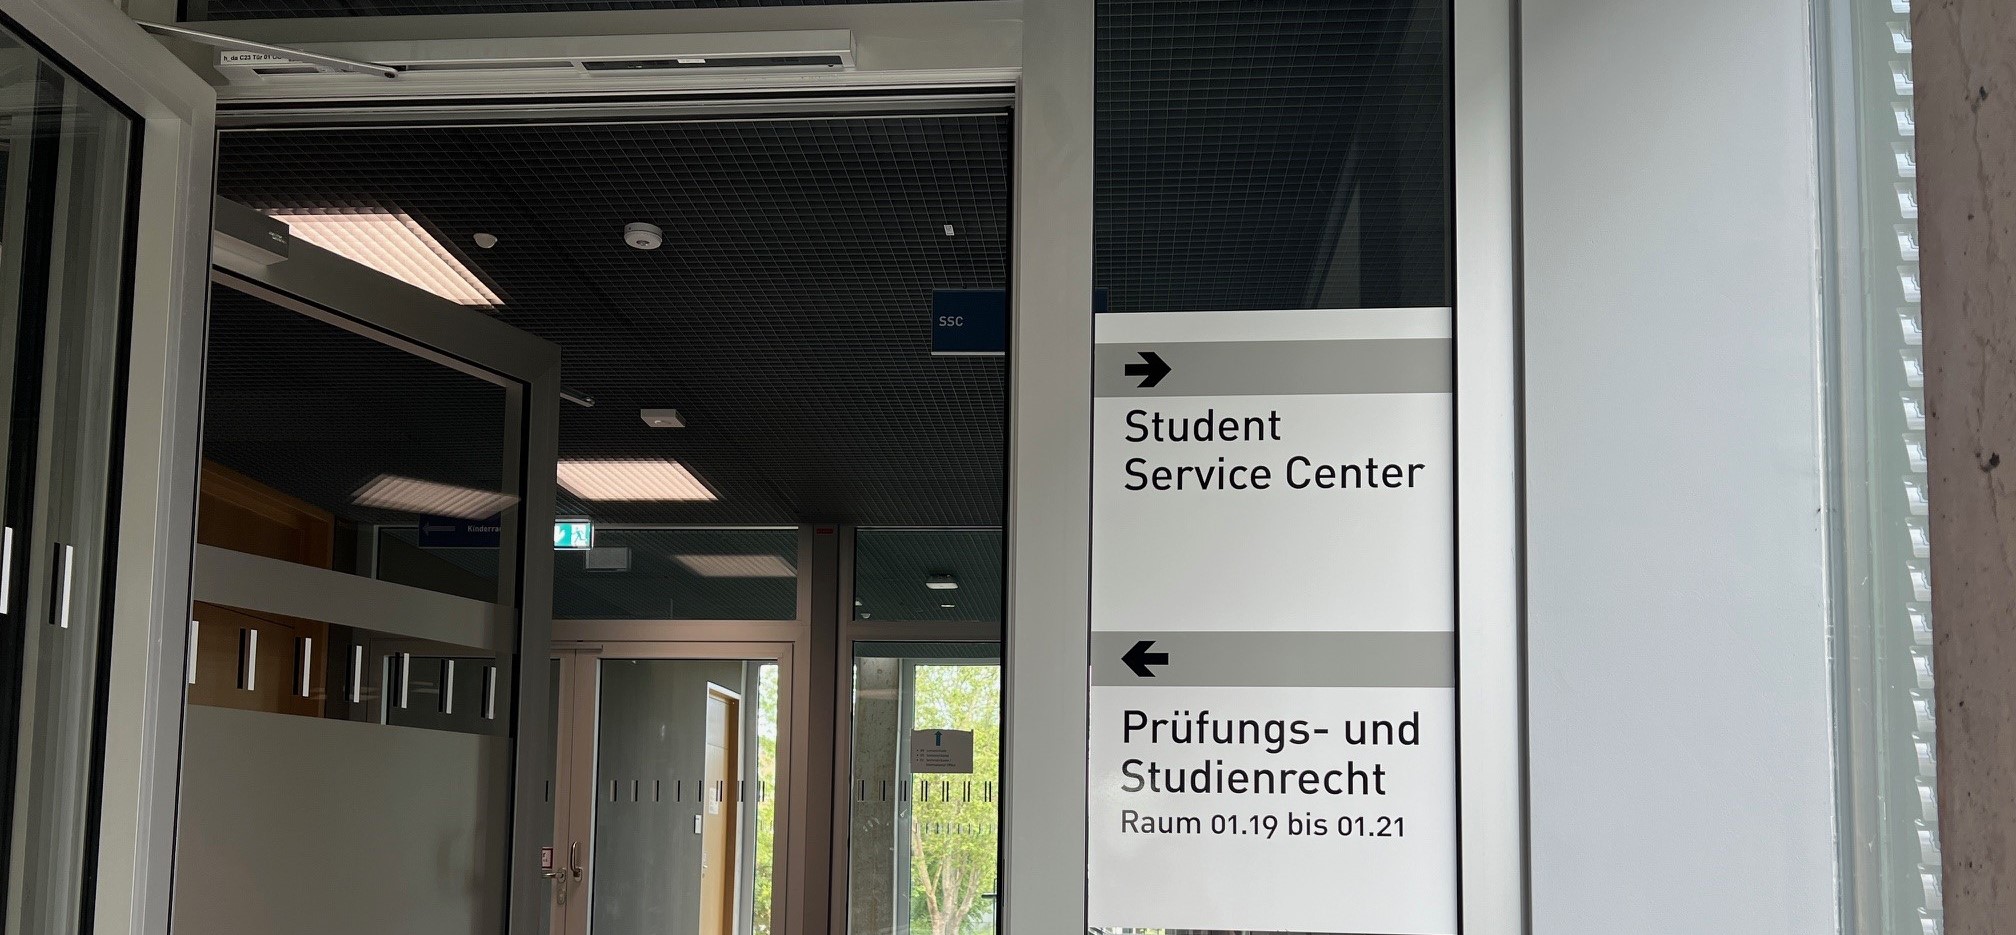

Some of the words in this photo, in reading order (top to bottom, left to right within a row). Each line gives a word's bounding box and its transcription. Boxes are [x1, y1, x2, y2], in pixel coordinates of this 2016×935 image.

[938, 315, 964, 327] SSC
[1124, 408, 1281, 443] Student
[1124, 456, 1272, 491] Service
[1286, 455, 1426, 490] Center
[467, 525, 502, 533] Kinderra
[1123, 709, 1329, 754] Prüfungs-
[1345, 711, 1419, 746] und
[1121, 758, 1386, 796] Studienrecht
[1121, 809, 1202, 835] Raum
[1210, 814, 1278, 840] 01.19
[1288, 811, 1328, 836] bis
[1337, 815, 1404, 838] 01.21
